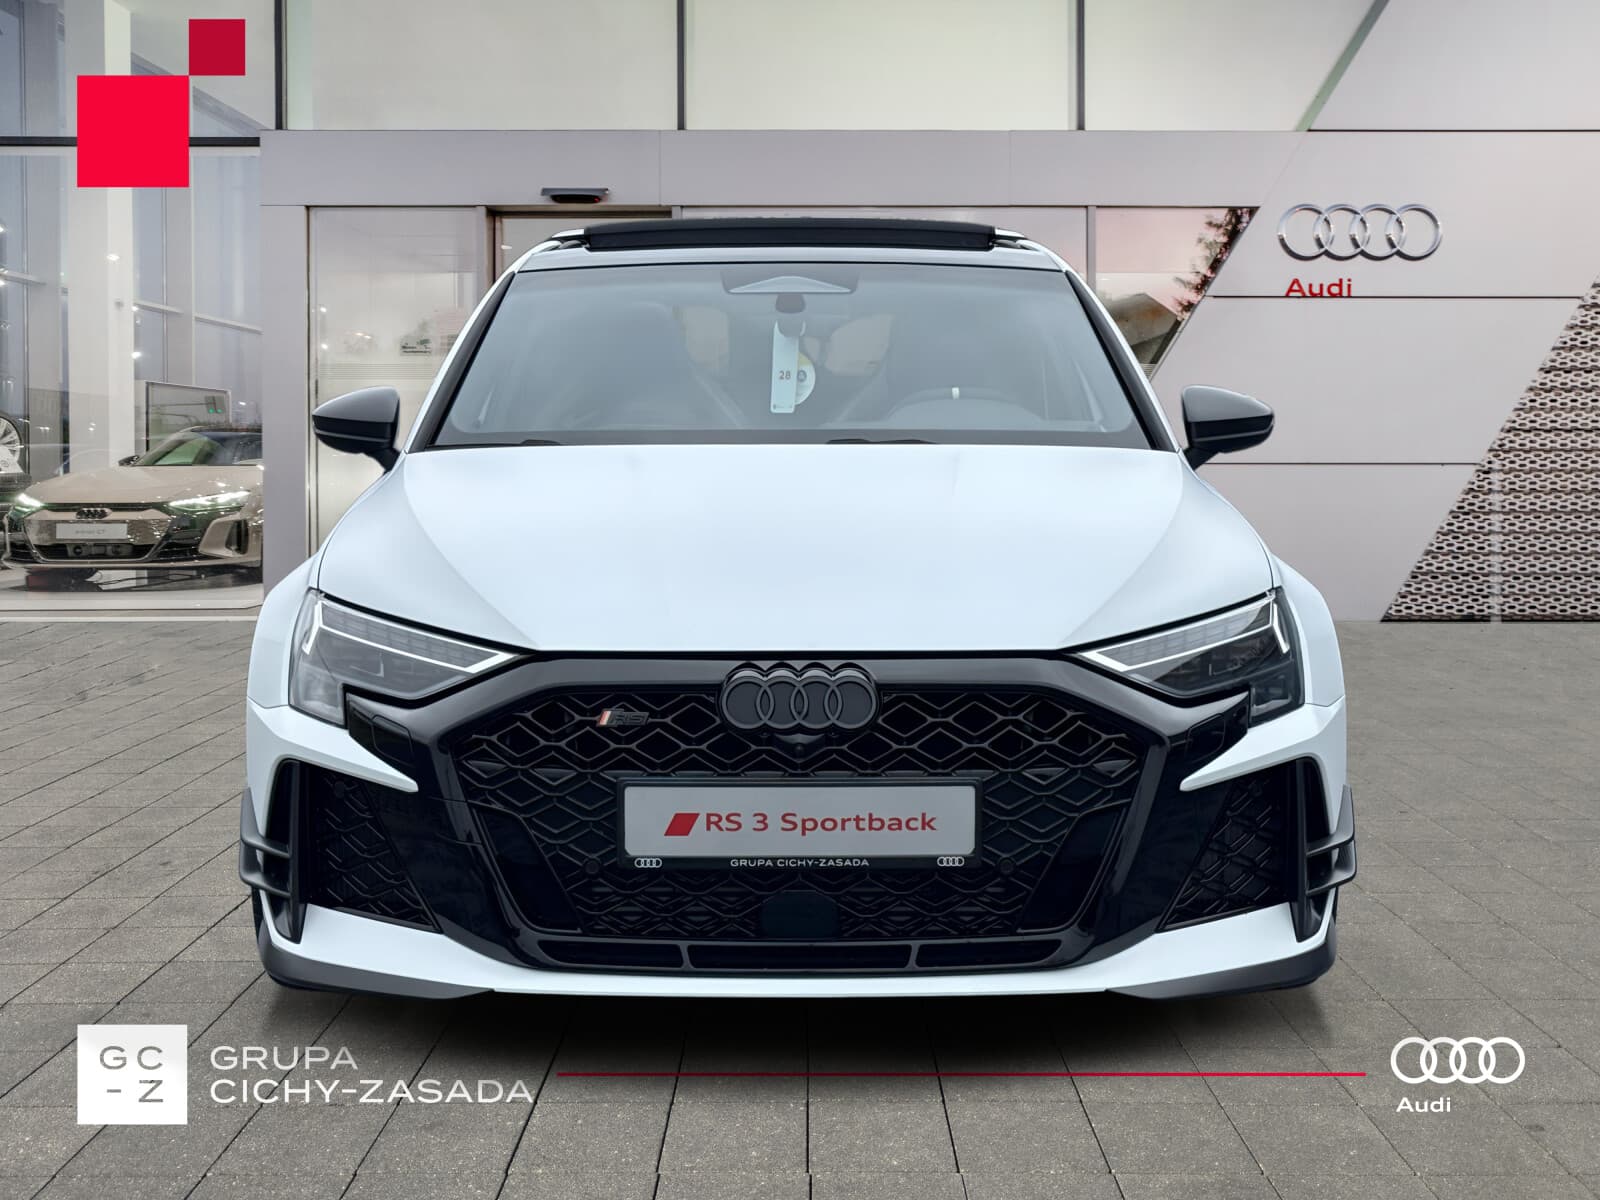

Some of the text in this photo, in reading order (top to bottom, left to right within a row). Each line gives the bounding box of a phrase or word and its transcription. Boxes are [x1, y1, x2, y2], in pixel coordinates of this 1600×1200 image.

[1285, 278, 1353, 297] Audi
[778, 370, 791, 381] 28
[705, 811, 937, 837] RS 3 Sportback
[730, 859, 870, 868] GRUPA CICHY-ZASADA
